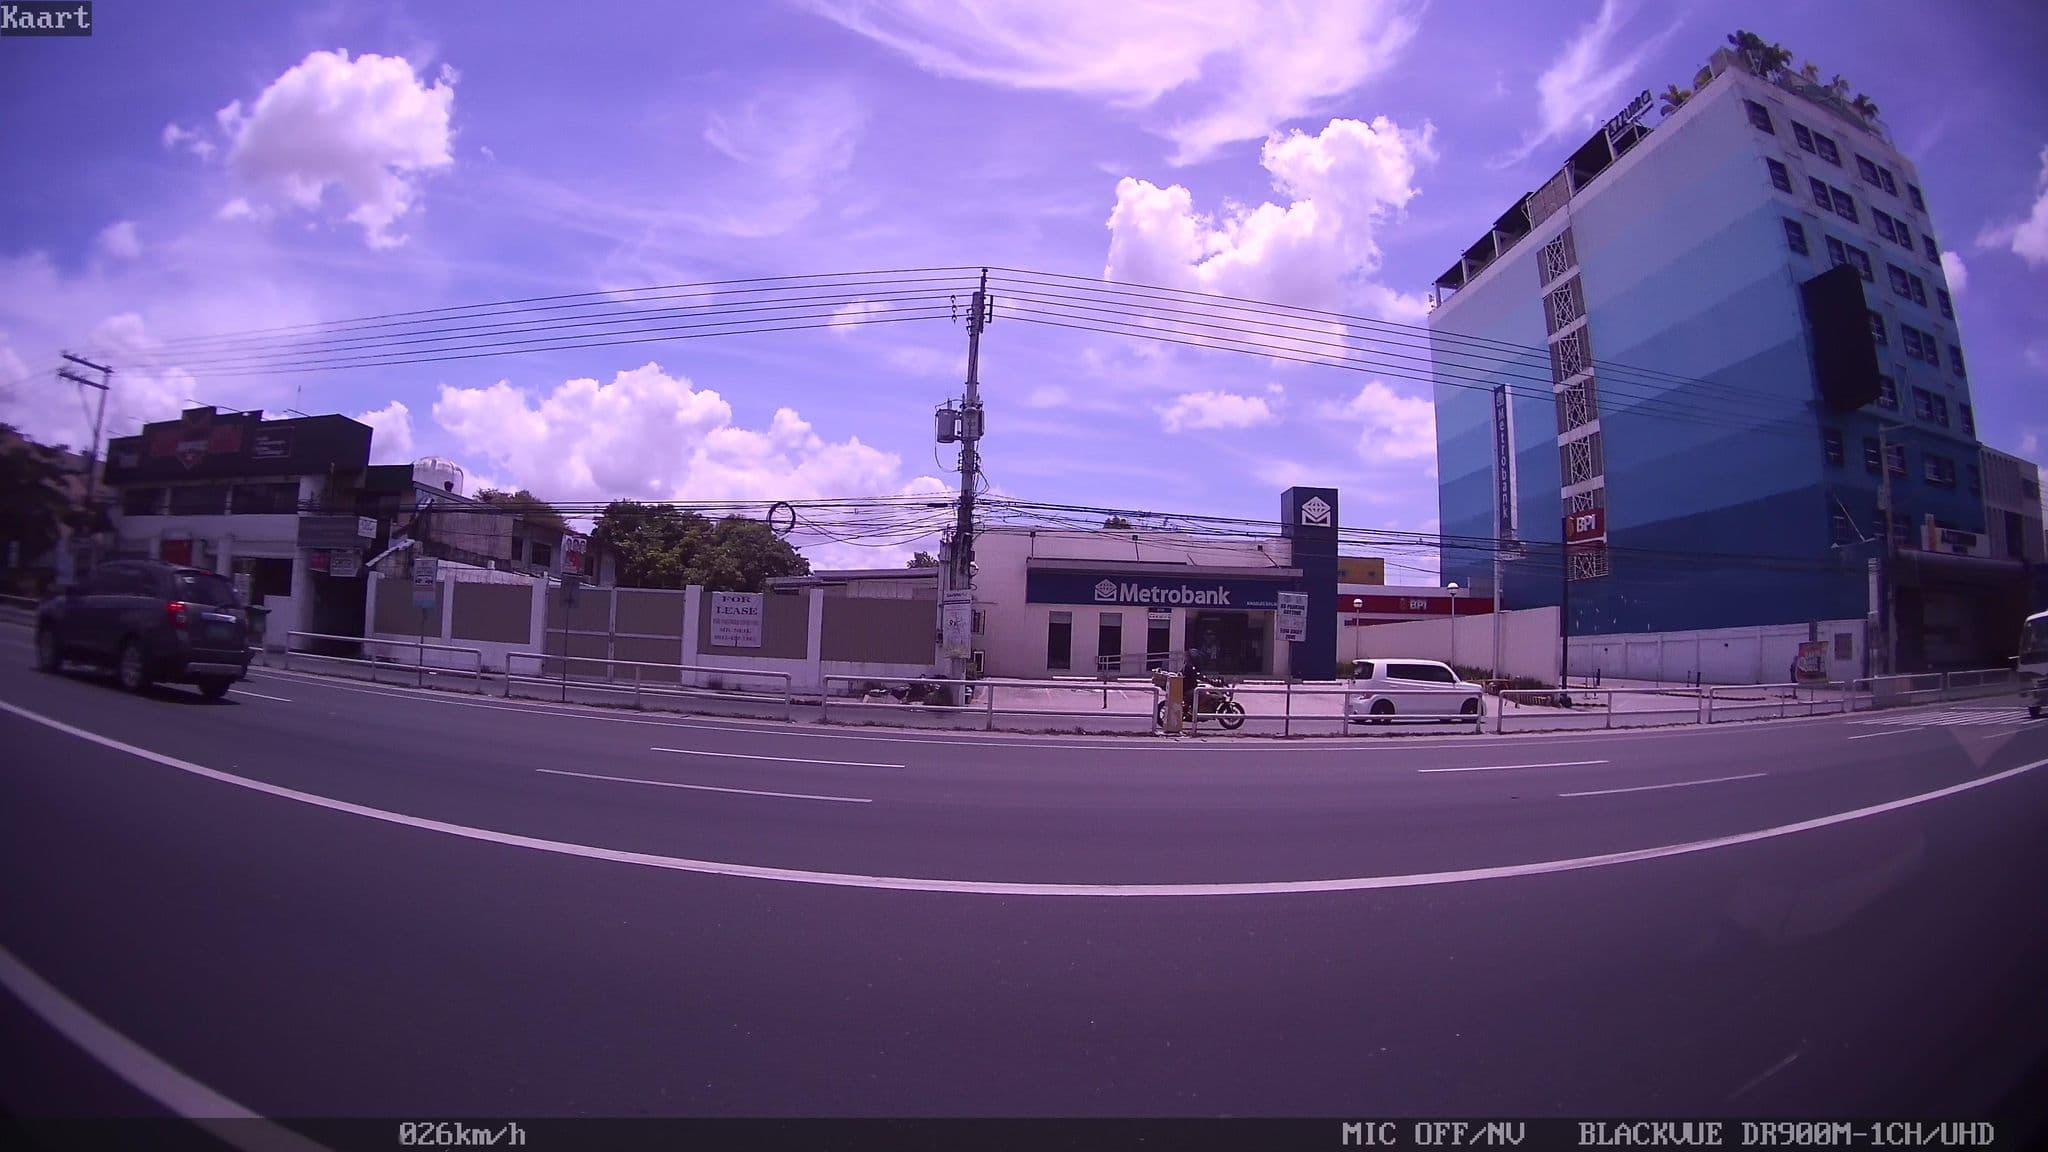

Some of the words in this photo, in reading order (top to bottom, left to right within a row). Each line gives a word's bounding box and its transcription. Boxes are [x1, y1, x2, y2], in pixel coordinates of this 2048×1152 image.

[1498, 409, 1509, 519] Metrobank
[1576, 514, 1596, 532] BPI
[1119, 583, 1230, 605] Metrobank
[716, 606, 758, 616] LEASE
[1409, 600, 1427, 610] BPI
